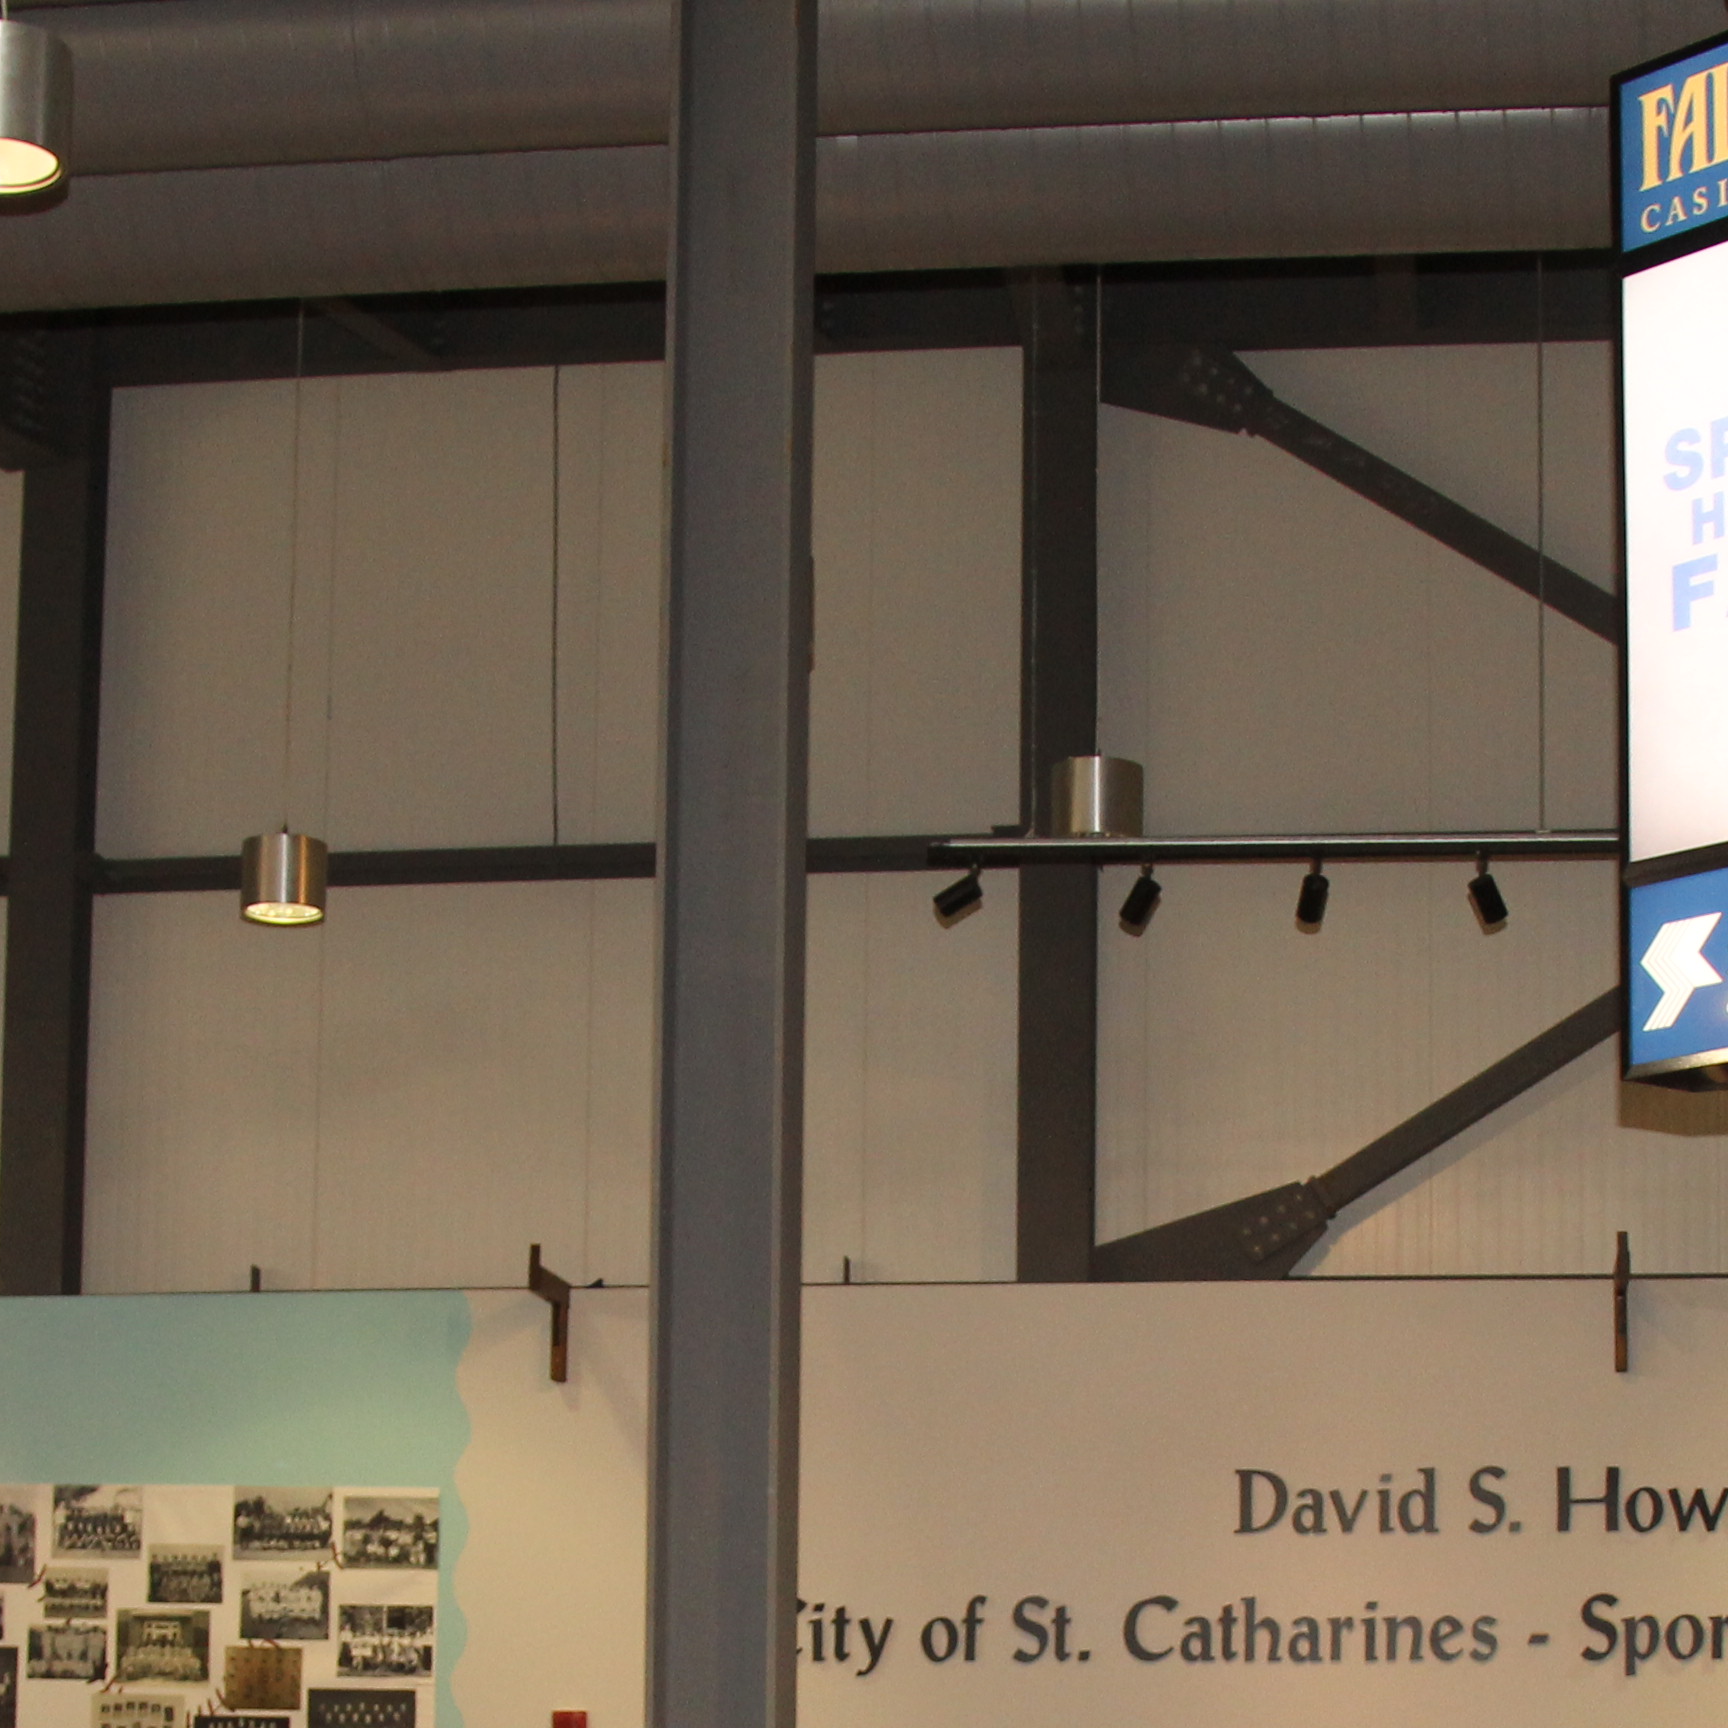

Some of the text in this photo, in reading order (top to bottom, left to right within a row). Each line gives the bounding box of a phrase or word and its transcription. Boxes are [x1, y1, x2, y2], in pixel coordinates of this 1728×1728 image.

[1233, 1467, 1439, 1535] David
[1468, 1465, 1524, 1535] S.
[796, 1596, 893, 1676] ity
[920, 1596, 986, 1662] of
[1012, 1596, 1092, 1664] St.
[1123, 1596, 1498, 1663] Catharines
